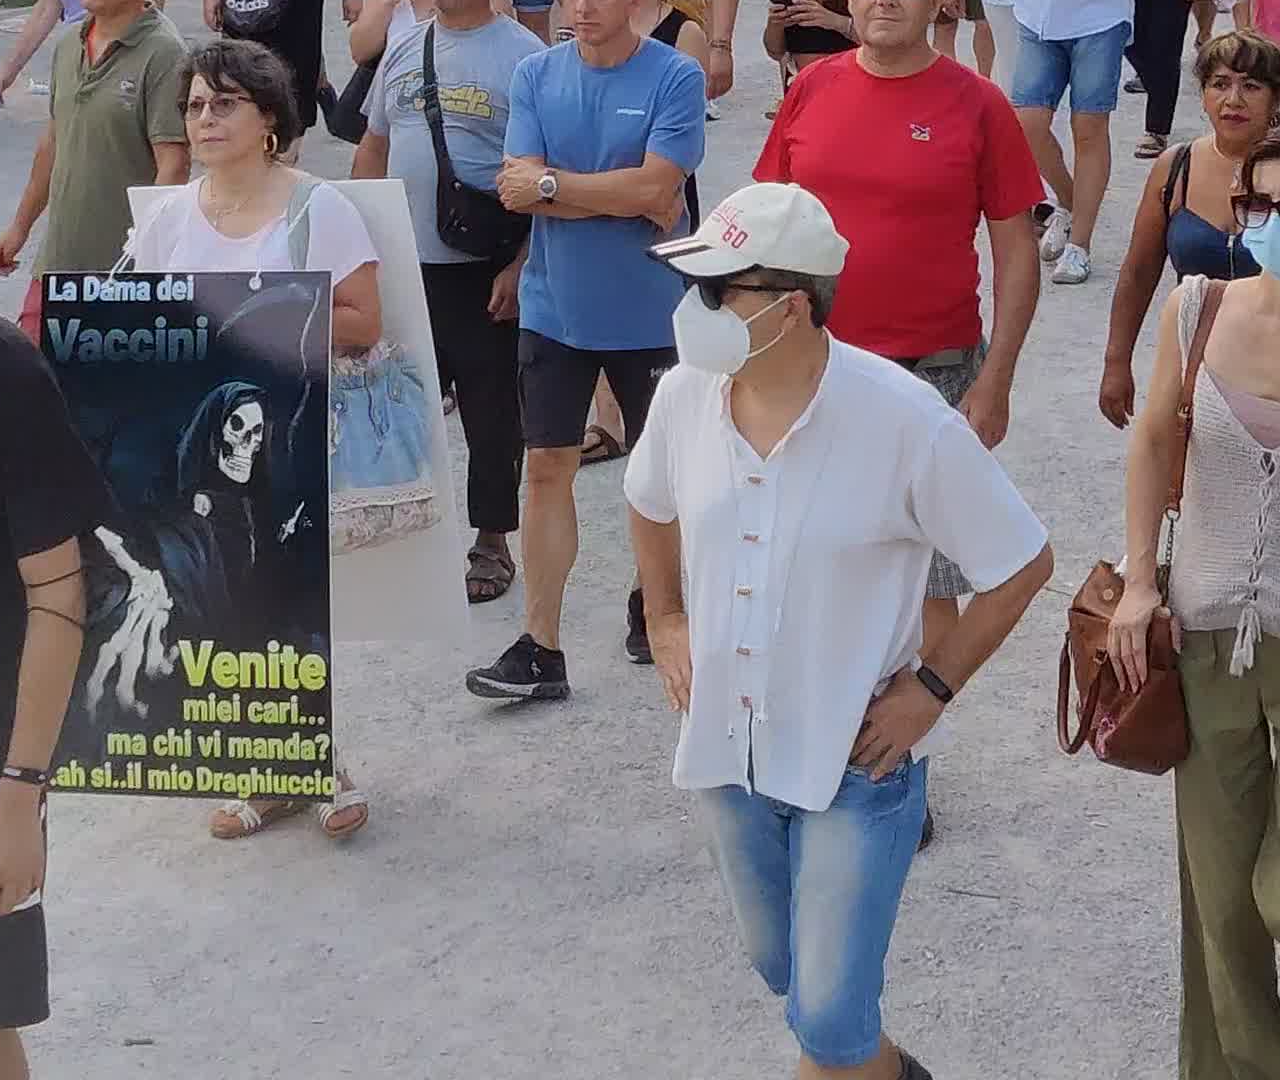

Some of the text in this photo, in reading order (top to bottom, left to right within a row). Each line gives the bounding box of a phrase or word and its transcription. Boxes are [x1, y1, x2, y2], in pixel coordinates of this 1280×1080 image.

[722, 223, 749, 249] 60
[48, 274, 194, 302] La Dama dei
[46, 315, 209, 362] Vaccini
[178, 639, 327, 691] Venite
[183, 692, 326, 724] miei cari...
[107, 727, 331, 761] ma chi vi manda?
[147, 763, 194, 791] mio
[196, 766, 336, 799] Draghiuccio
